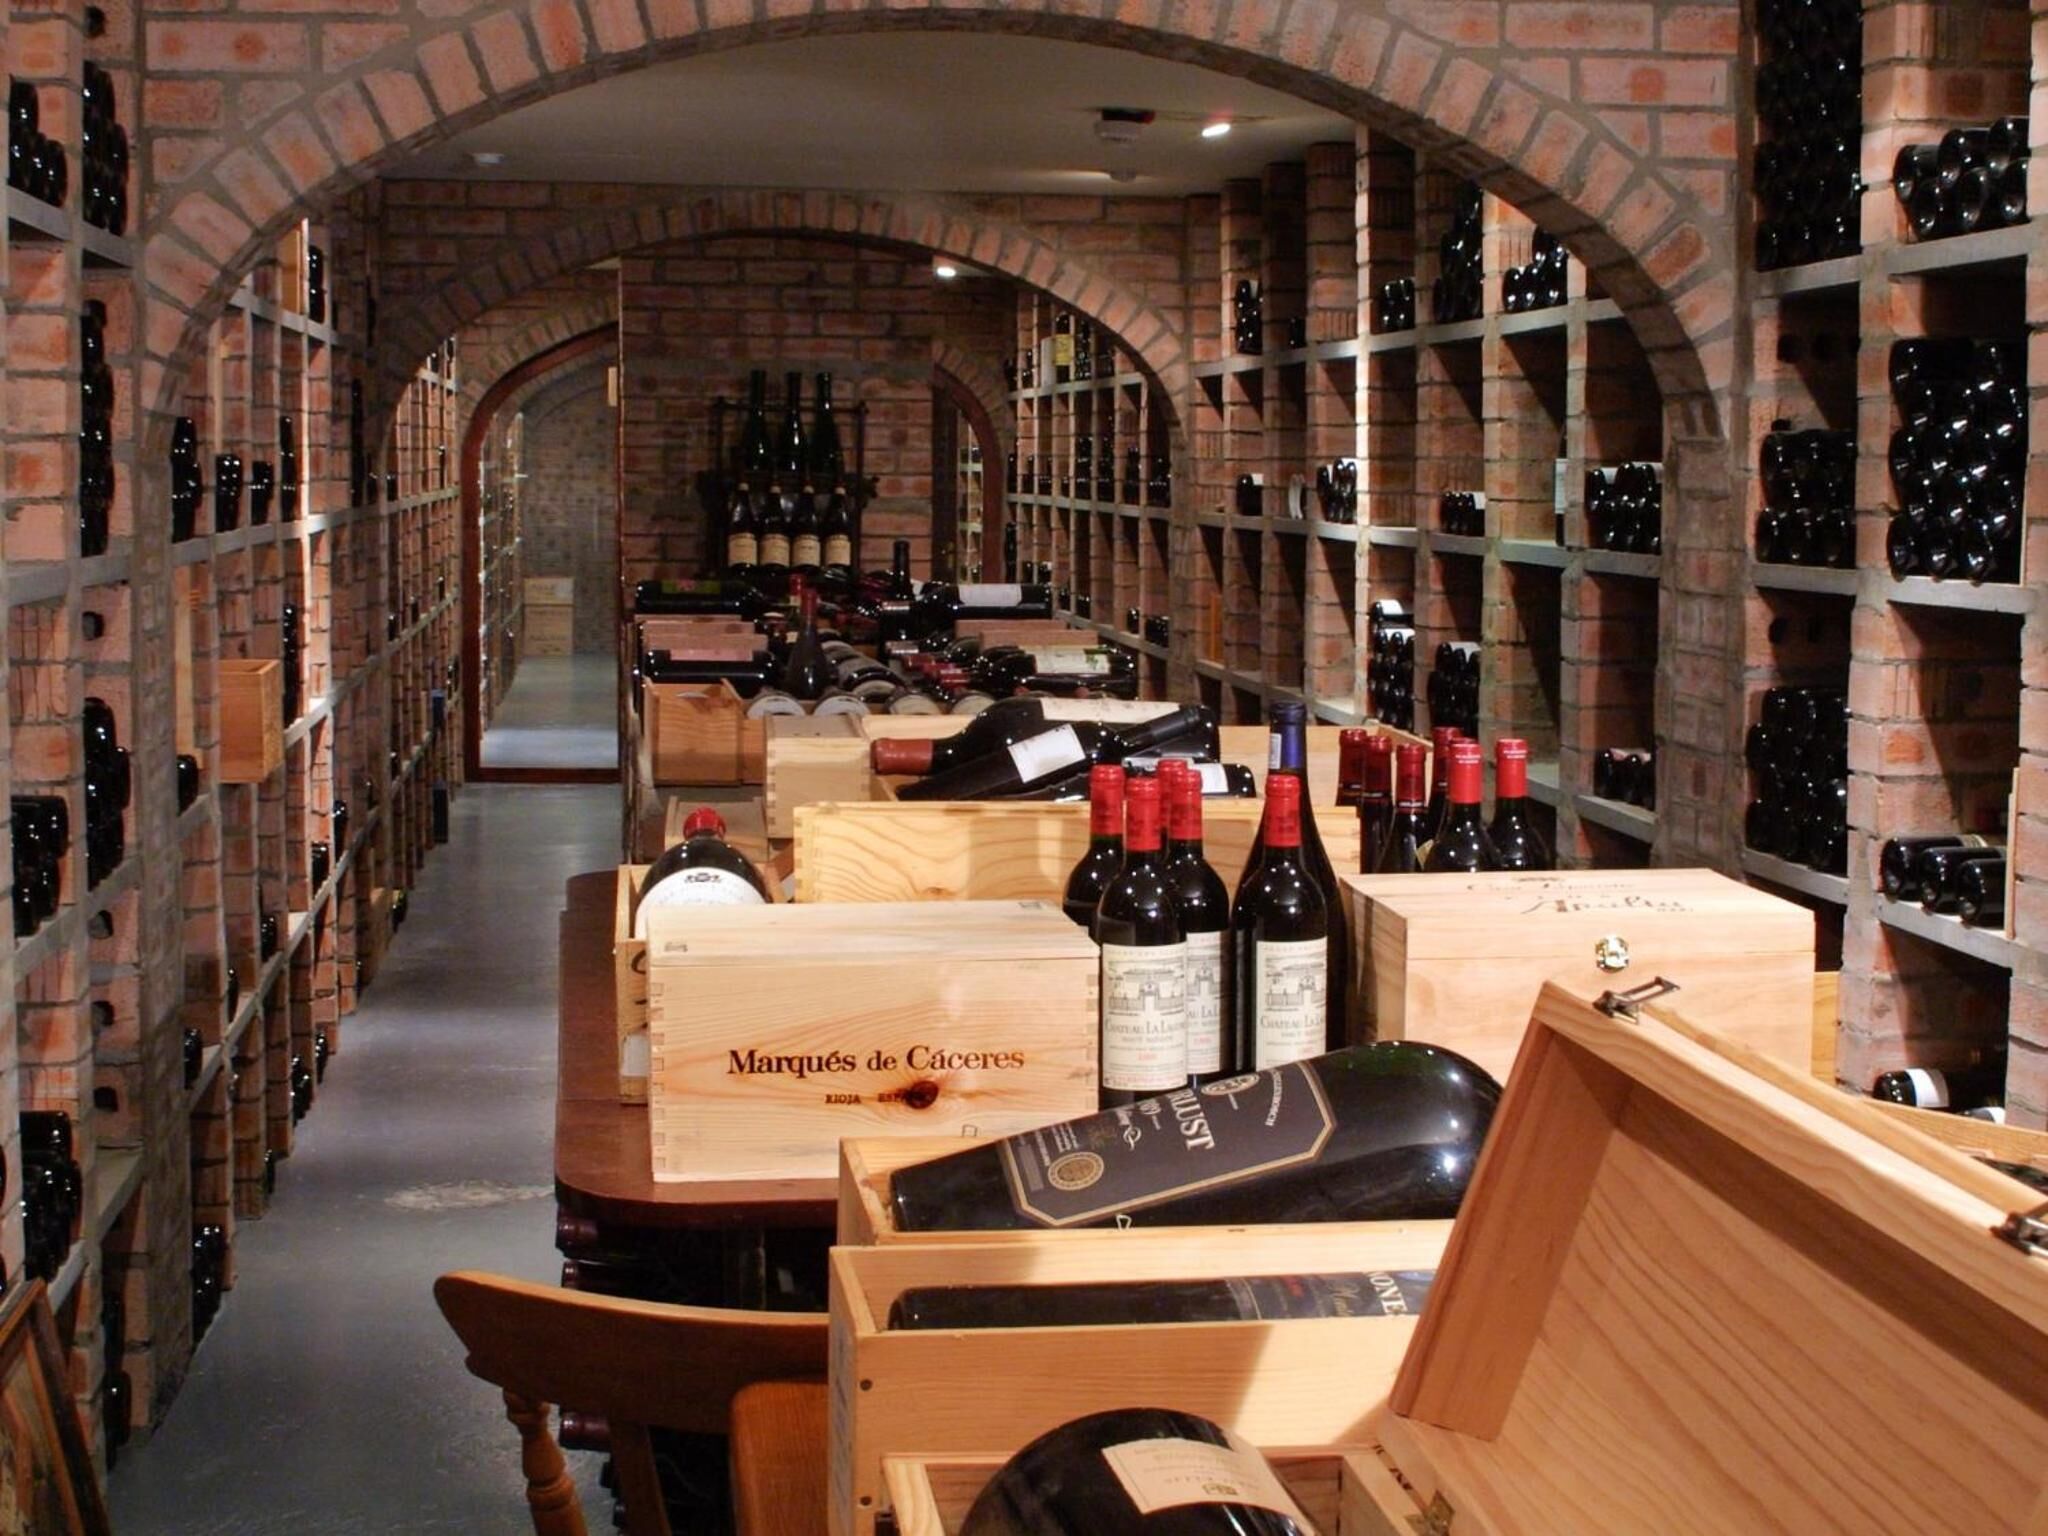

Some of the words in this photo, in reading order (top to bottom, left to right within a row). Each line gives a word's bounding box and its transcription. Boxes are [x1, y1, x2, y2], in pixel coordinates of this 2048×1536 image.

[727, 1049, 857, 1079] Marqués
[866, 1050, 897, 1071] de
[906, 1045, 1025, 1071] Cáceres
[825, 1093, 861, 1105] RIOJA
[1366, 1271, 1408, 1313] ONE
